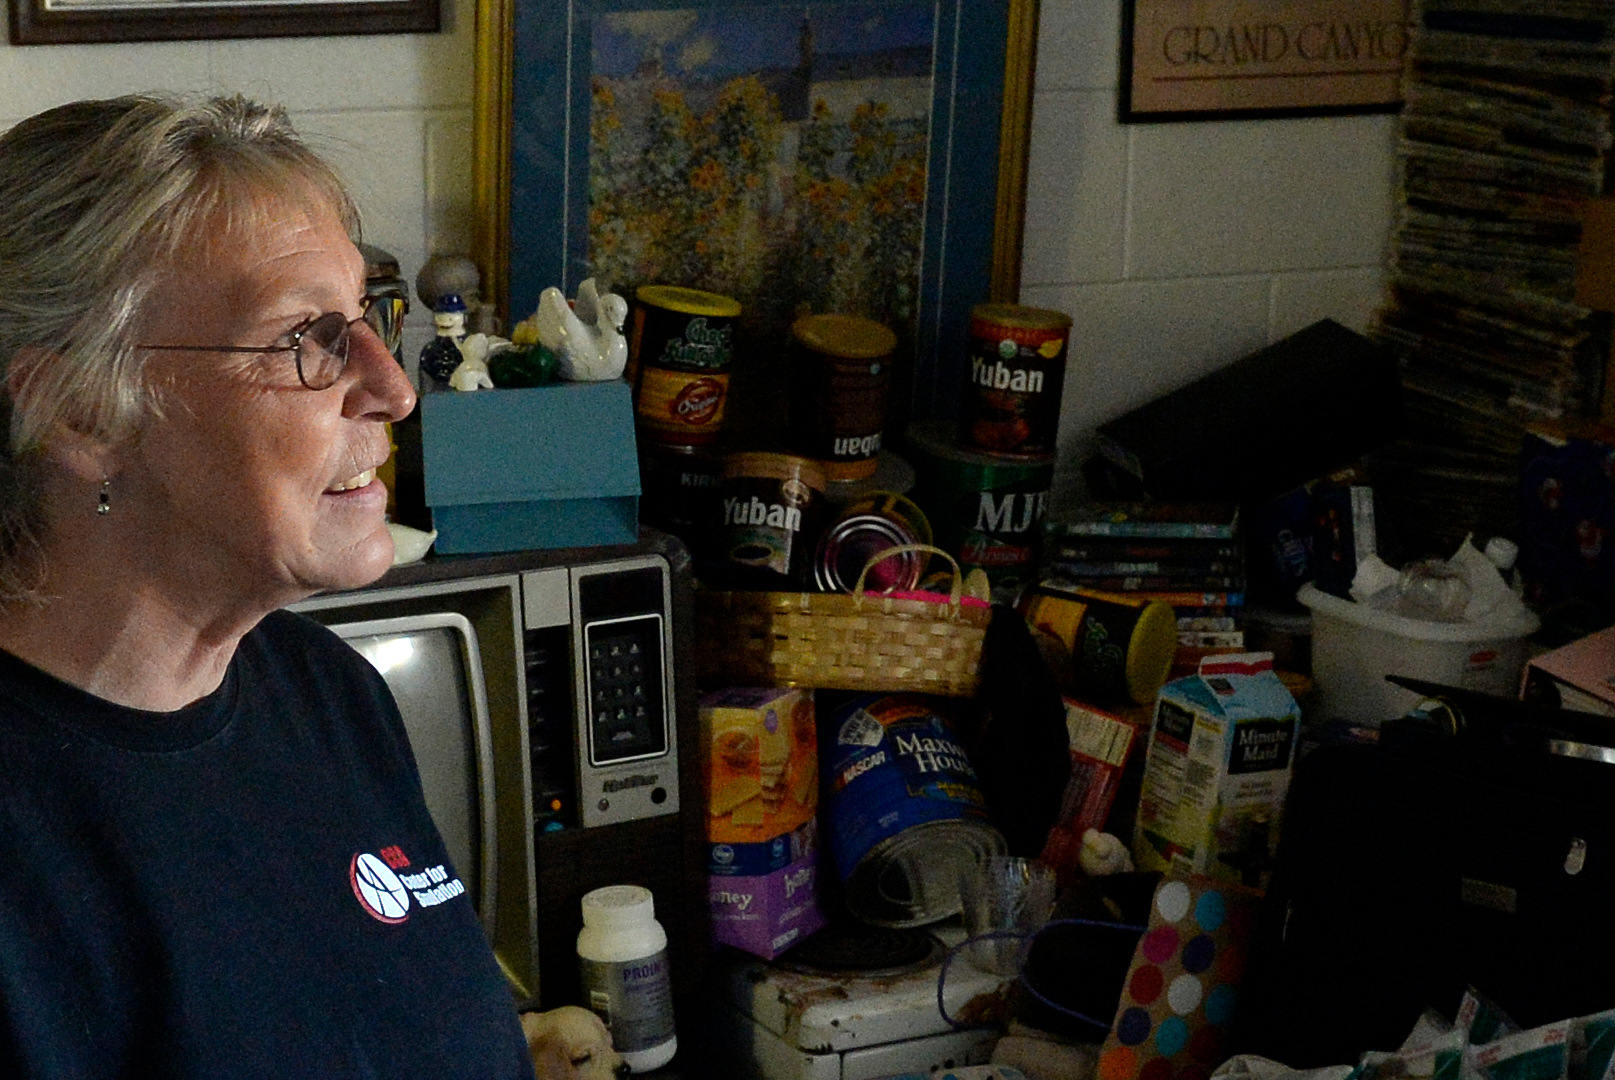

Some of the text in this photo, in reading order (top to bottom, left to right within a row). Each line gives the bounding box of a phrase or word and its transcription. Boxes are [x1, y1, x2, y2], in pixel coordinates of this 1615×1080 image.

[1163, 21, 1414, 65] GRAND CANYO
[970, 354, 1045, 394] Yuban
[833, 432, 882, 458] uban
[722, 496, 803, 533] Yuban
[1238, 727, 1288, 746] Minute
[1243, 745, 1279, 762] Maid
[425, 864, 449, 884] for
